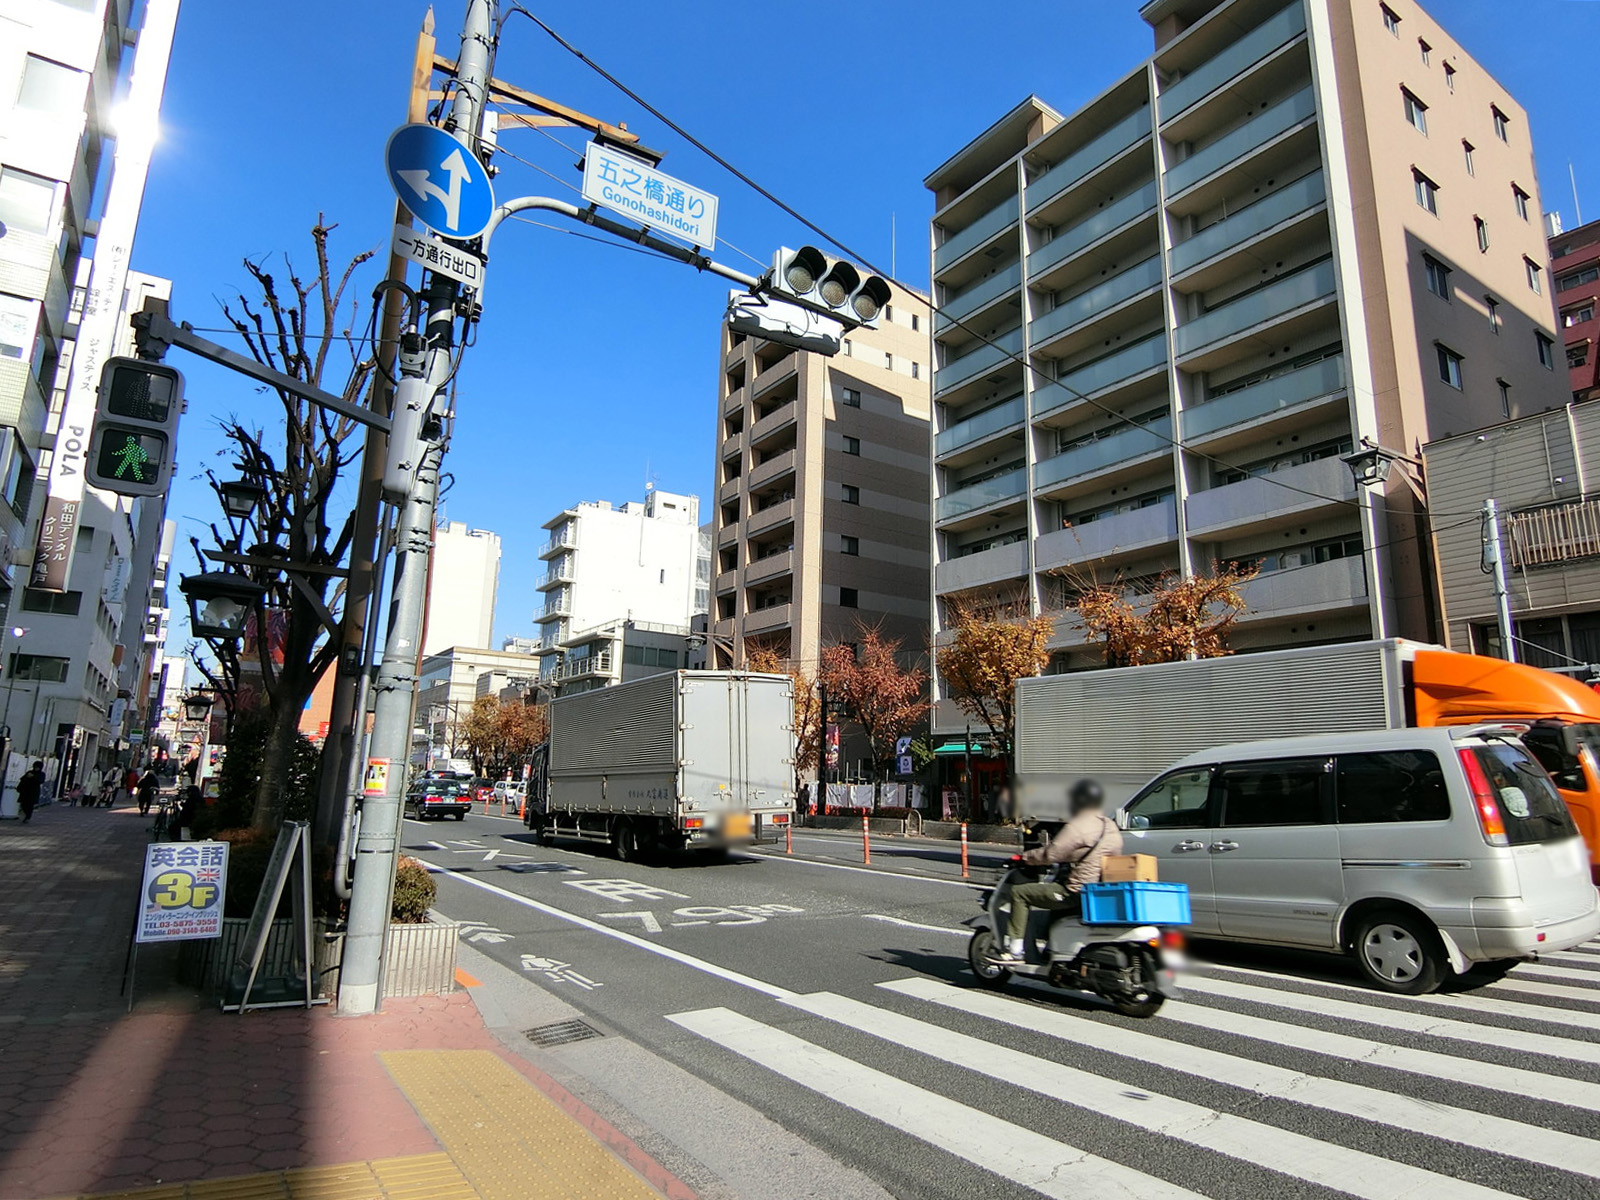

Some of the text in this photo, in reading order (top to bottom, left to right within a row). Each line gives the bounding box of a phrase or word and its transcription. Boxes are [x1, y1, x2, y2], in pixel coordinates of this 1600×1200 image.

[597, 157, 705, 220] 五之橋通り
[603, 186, 700, 236] Gonohashidori
[398, 238, 477, 281] 一方通行出口
[81, 338, 100, 391] ジャスティス
[60, 425, 84, 476] POLA
[33, 516, 57, 584] クリニック亀戸
[53, 503, 76, 562] 和田デンタル
[151, 846, 224, 868] 英会話
[155, 872, 215, 907] 3F
